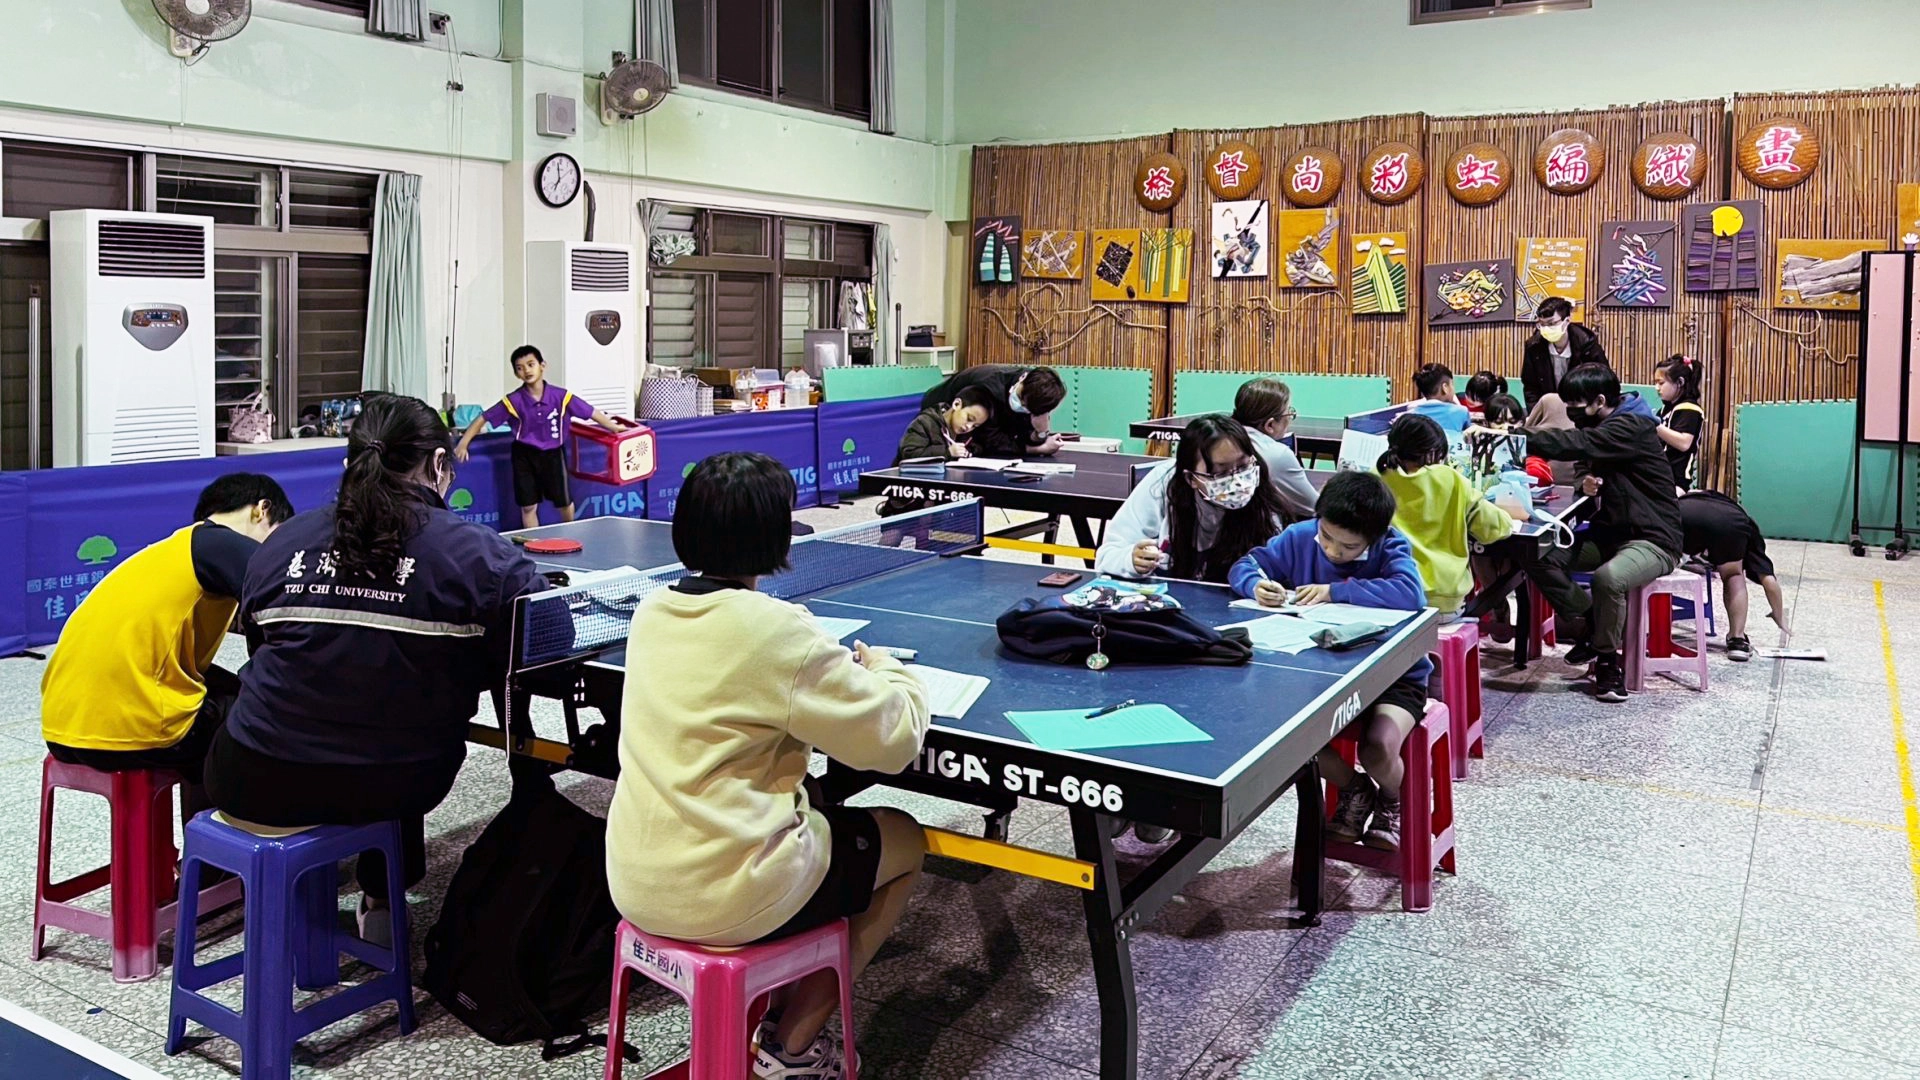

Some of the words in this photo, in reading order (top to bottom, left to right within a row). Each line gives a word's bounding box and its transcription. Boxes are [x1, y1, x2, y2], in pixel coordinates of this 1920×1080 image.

[1148, 431, 1181, 440] STIGA
[790, 466, 817, 486] TIG
[882, 485, 925, 499] STIGA
[574, 491, 645, 520] STIGA
[286, 550, 415, 586] 慈濟學
[26, 570, 106, 593] 國泰世華銀
[285, 584, 304, 594] TZU
[308, 584, 331, 594] CHI
[335, 586, 406, 603] UNIVERSITY
[1330, 690, 1362, 737] STIGA
[912, 747, 991, 786] TIGA
[1003, 763, 1124, 812] ST-666
